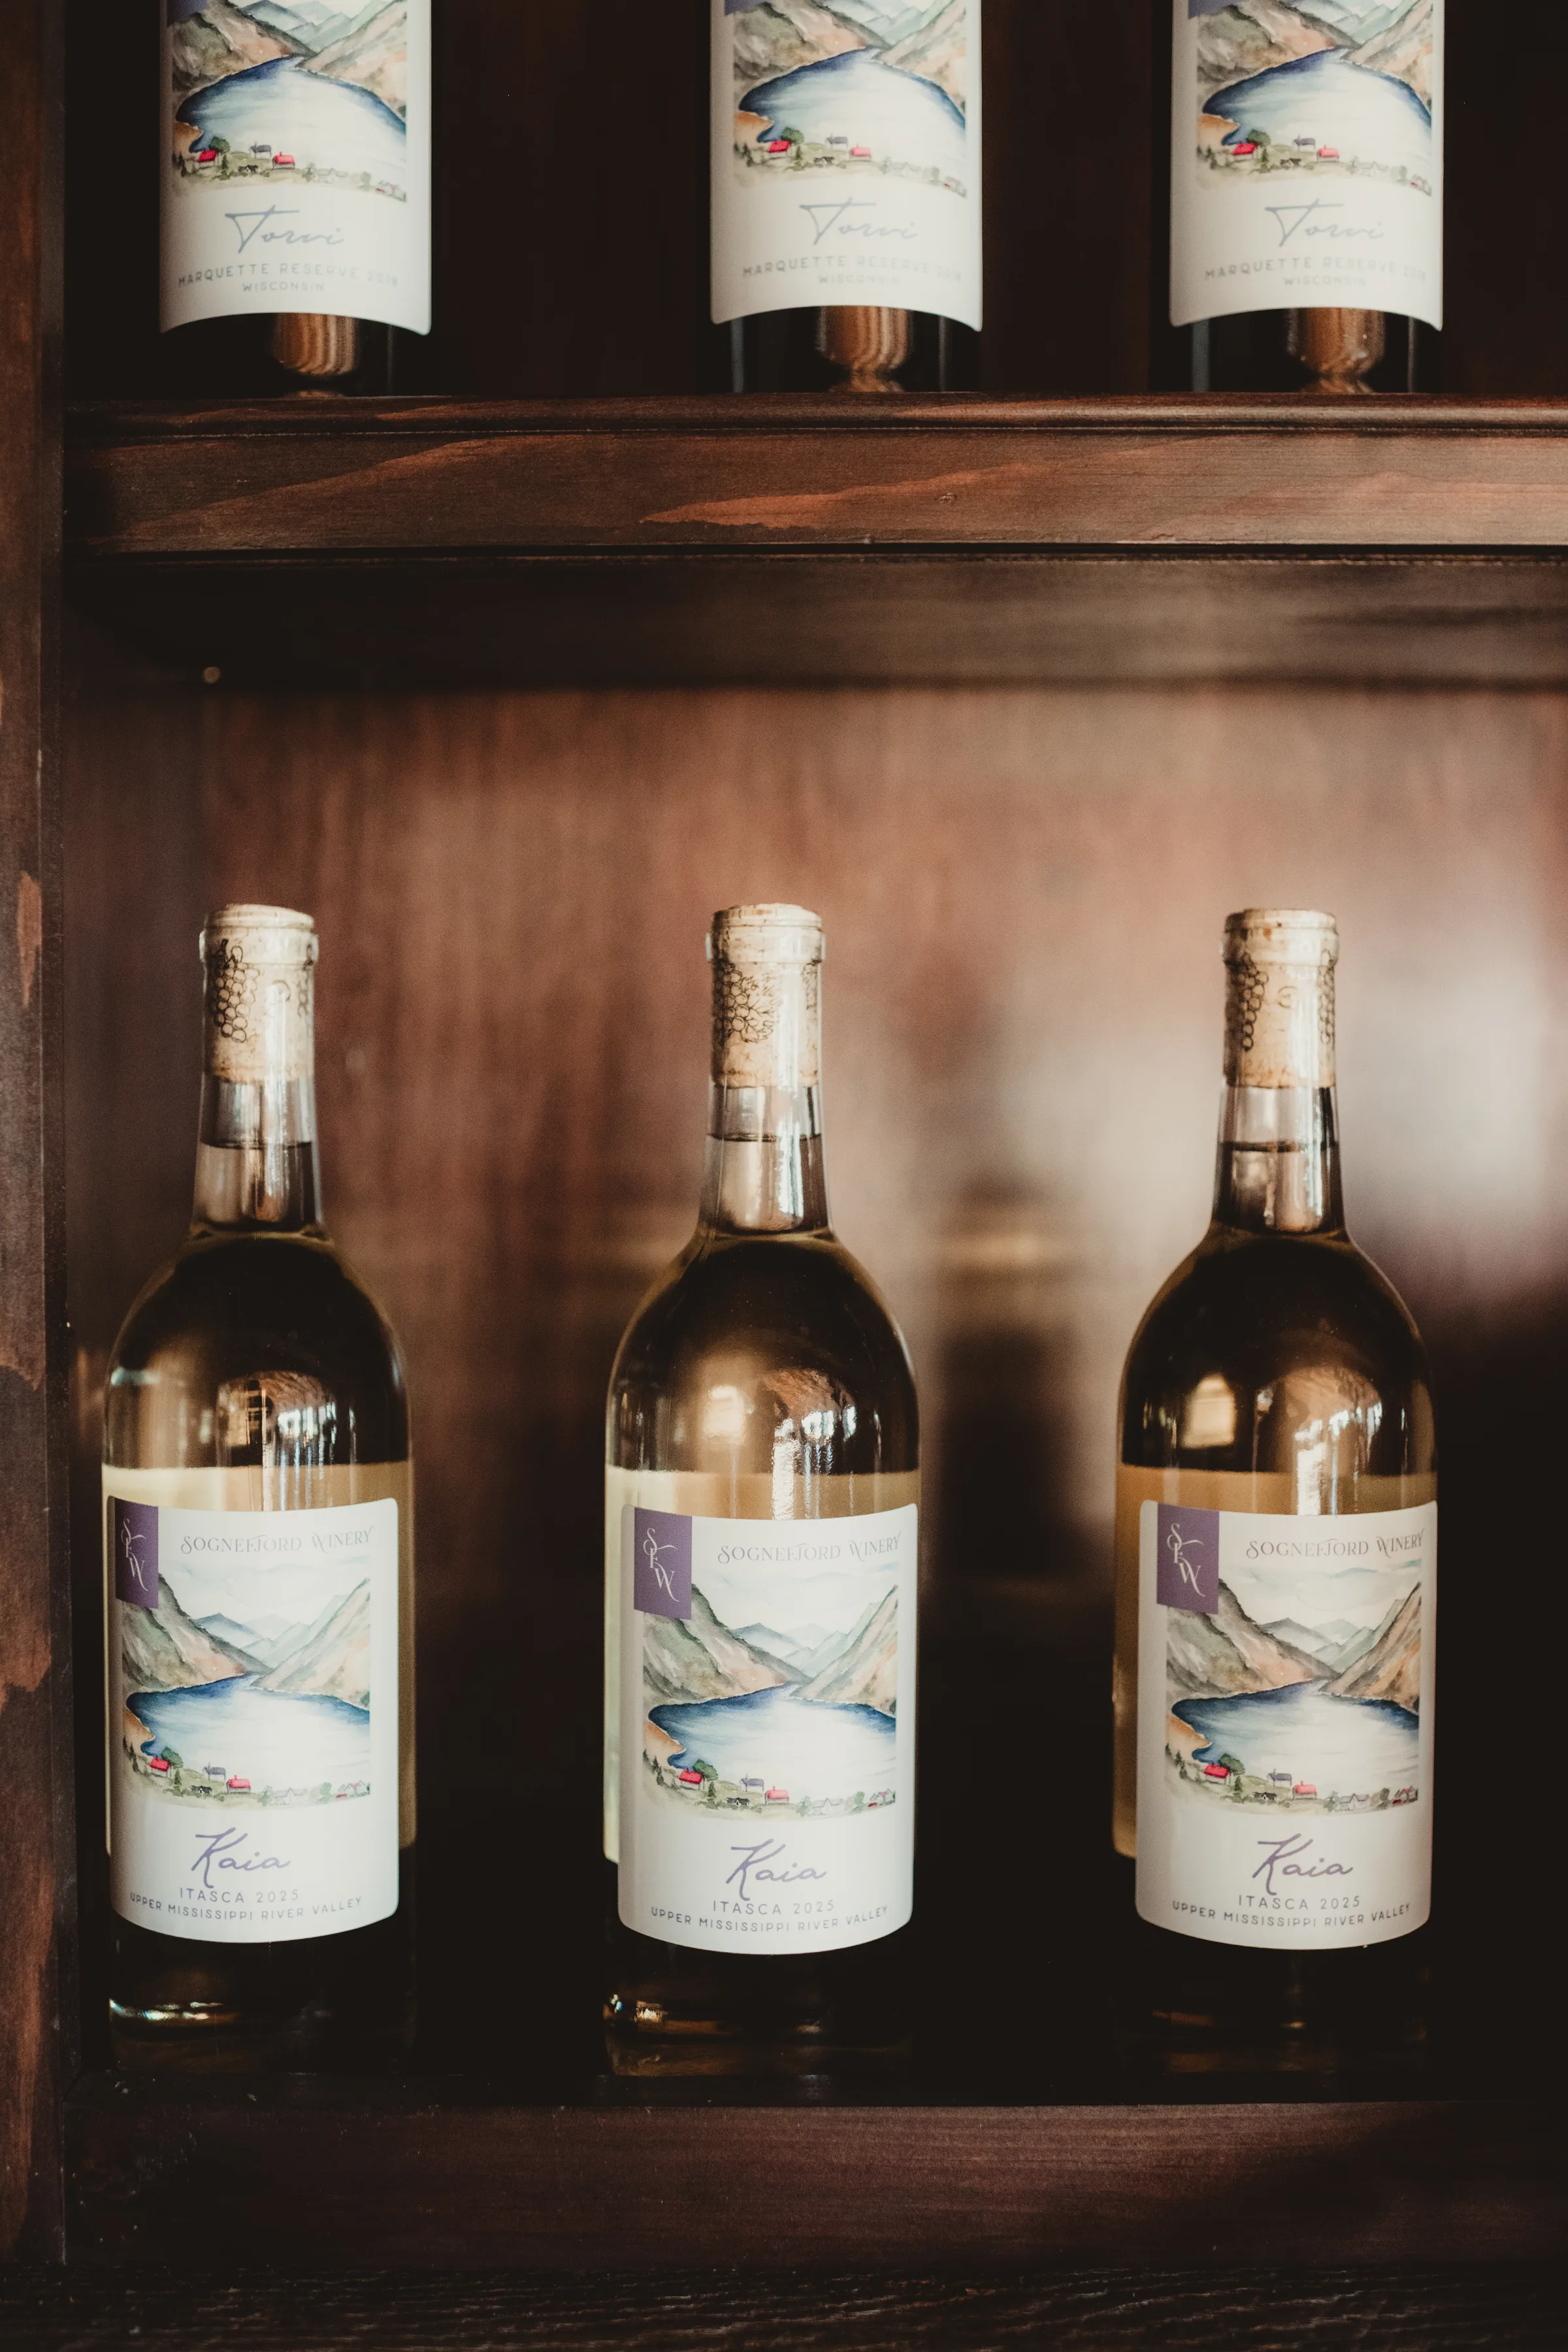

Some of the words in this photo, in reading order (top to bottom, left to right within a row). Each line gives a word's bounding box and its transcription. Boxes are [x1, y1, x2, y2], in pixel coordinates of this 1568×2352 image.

[178, 263, 269, 289] MARQUETTE
[280, 263, 359, 280] RESERVE
[742, 255, 846, 278] MARQUETTE
[855, 255, 928, 274] RESERVE
[1205, 257, 1312, 280] MARQUETTE
[1322, 257, 1396, 274] RESERVE
[242, 282, 324, 292] WISCONSIN
[310, 1525, 374, 1554] WINERY
[849, 1531, 902, 1562] WINERY
[1376, 1528, 1425, 1559] WINERY
[191, 1827, 291, 1889] Kaia
[725, 1838, 827, 1901] Kaia
[1252, 1833, 1353, 1895] Kaia
[130, 1892, 162, 1912] UPPER
[169, 1904, 252, 1920] MISSISSIPPI
[261, 1907, 304, 1919] RIVER
[312, 1896, 362, 1915] VALLEY
[180, 1887, 245, 1903] ITASCA
[256, 1889, 299, 1903] 2025
[713, 1900, 781, 1915] ITASCA
[793, 1900, 834, 1914] 2025
[1239, 1895, 1308, 1910] ITASCA
[1320, 1895, 1360, 1910] 2025
[651, 1906, 691, 1925] UPPER
[699, 1918, 789, 1932] MISSISSIPPI
[798, 1918, 838, 1931] RIVER
[845, 1905, 888, 1925] VALLEY
[1172, 1901, 1215, 1919] UPPER
[1224, 1912, 1316, 1927] MISSISSIPPI
[1325, 1914, 1364, 1927] RIVER
[1371, 1903, 1411, 1921] VALLEY
